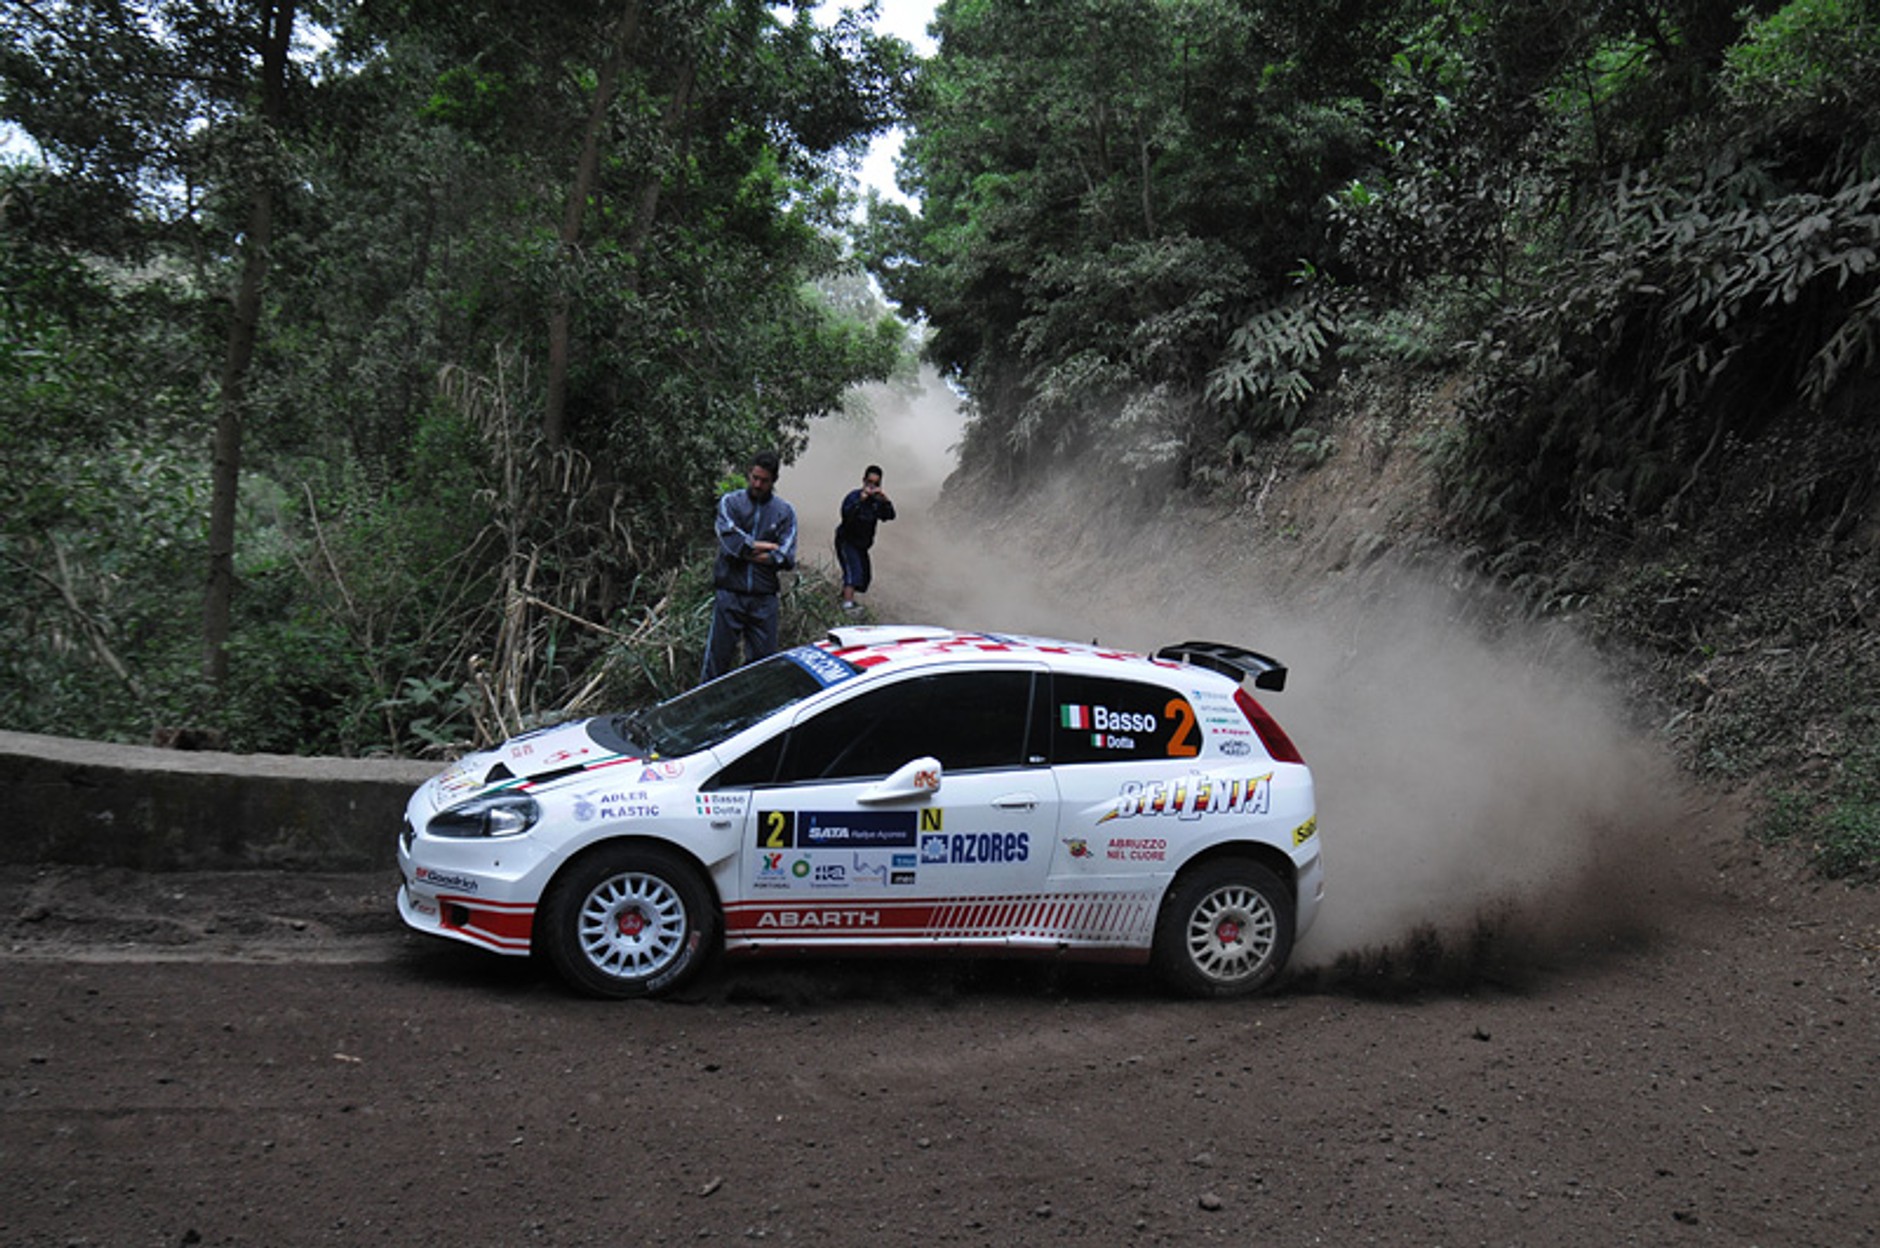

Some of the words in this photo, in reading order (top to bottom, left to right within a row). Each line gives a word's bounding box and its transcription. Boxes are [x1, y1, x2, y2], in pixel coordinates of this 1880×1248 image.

[1093, 705, 1156, 732] Basso
[1164, 698, 1197, 756] 2
[1107, 735, 1134, 749] Dotta
[601, 792, 648, 803] ADLER
[601, 806, 660, 819] PLASTIC
[921, 809, 942, 830] N
[766, 811, 786, 848] 2
[808, 827, 850, 839] SATA
[1108, 839, 1167, 850] ABRUZZO
[1107, 851, 1126, 861] NEL
[1130, 851, 1165, 861] CUORE
[757, 911, 880, 928] ABARTH
